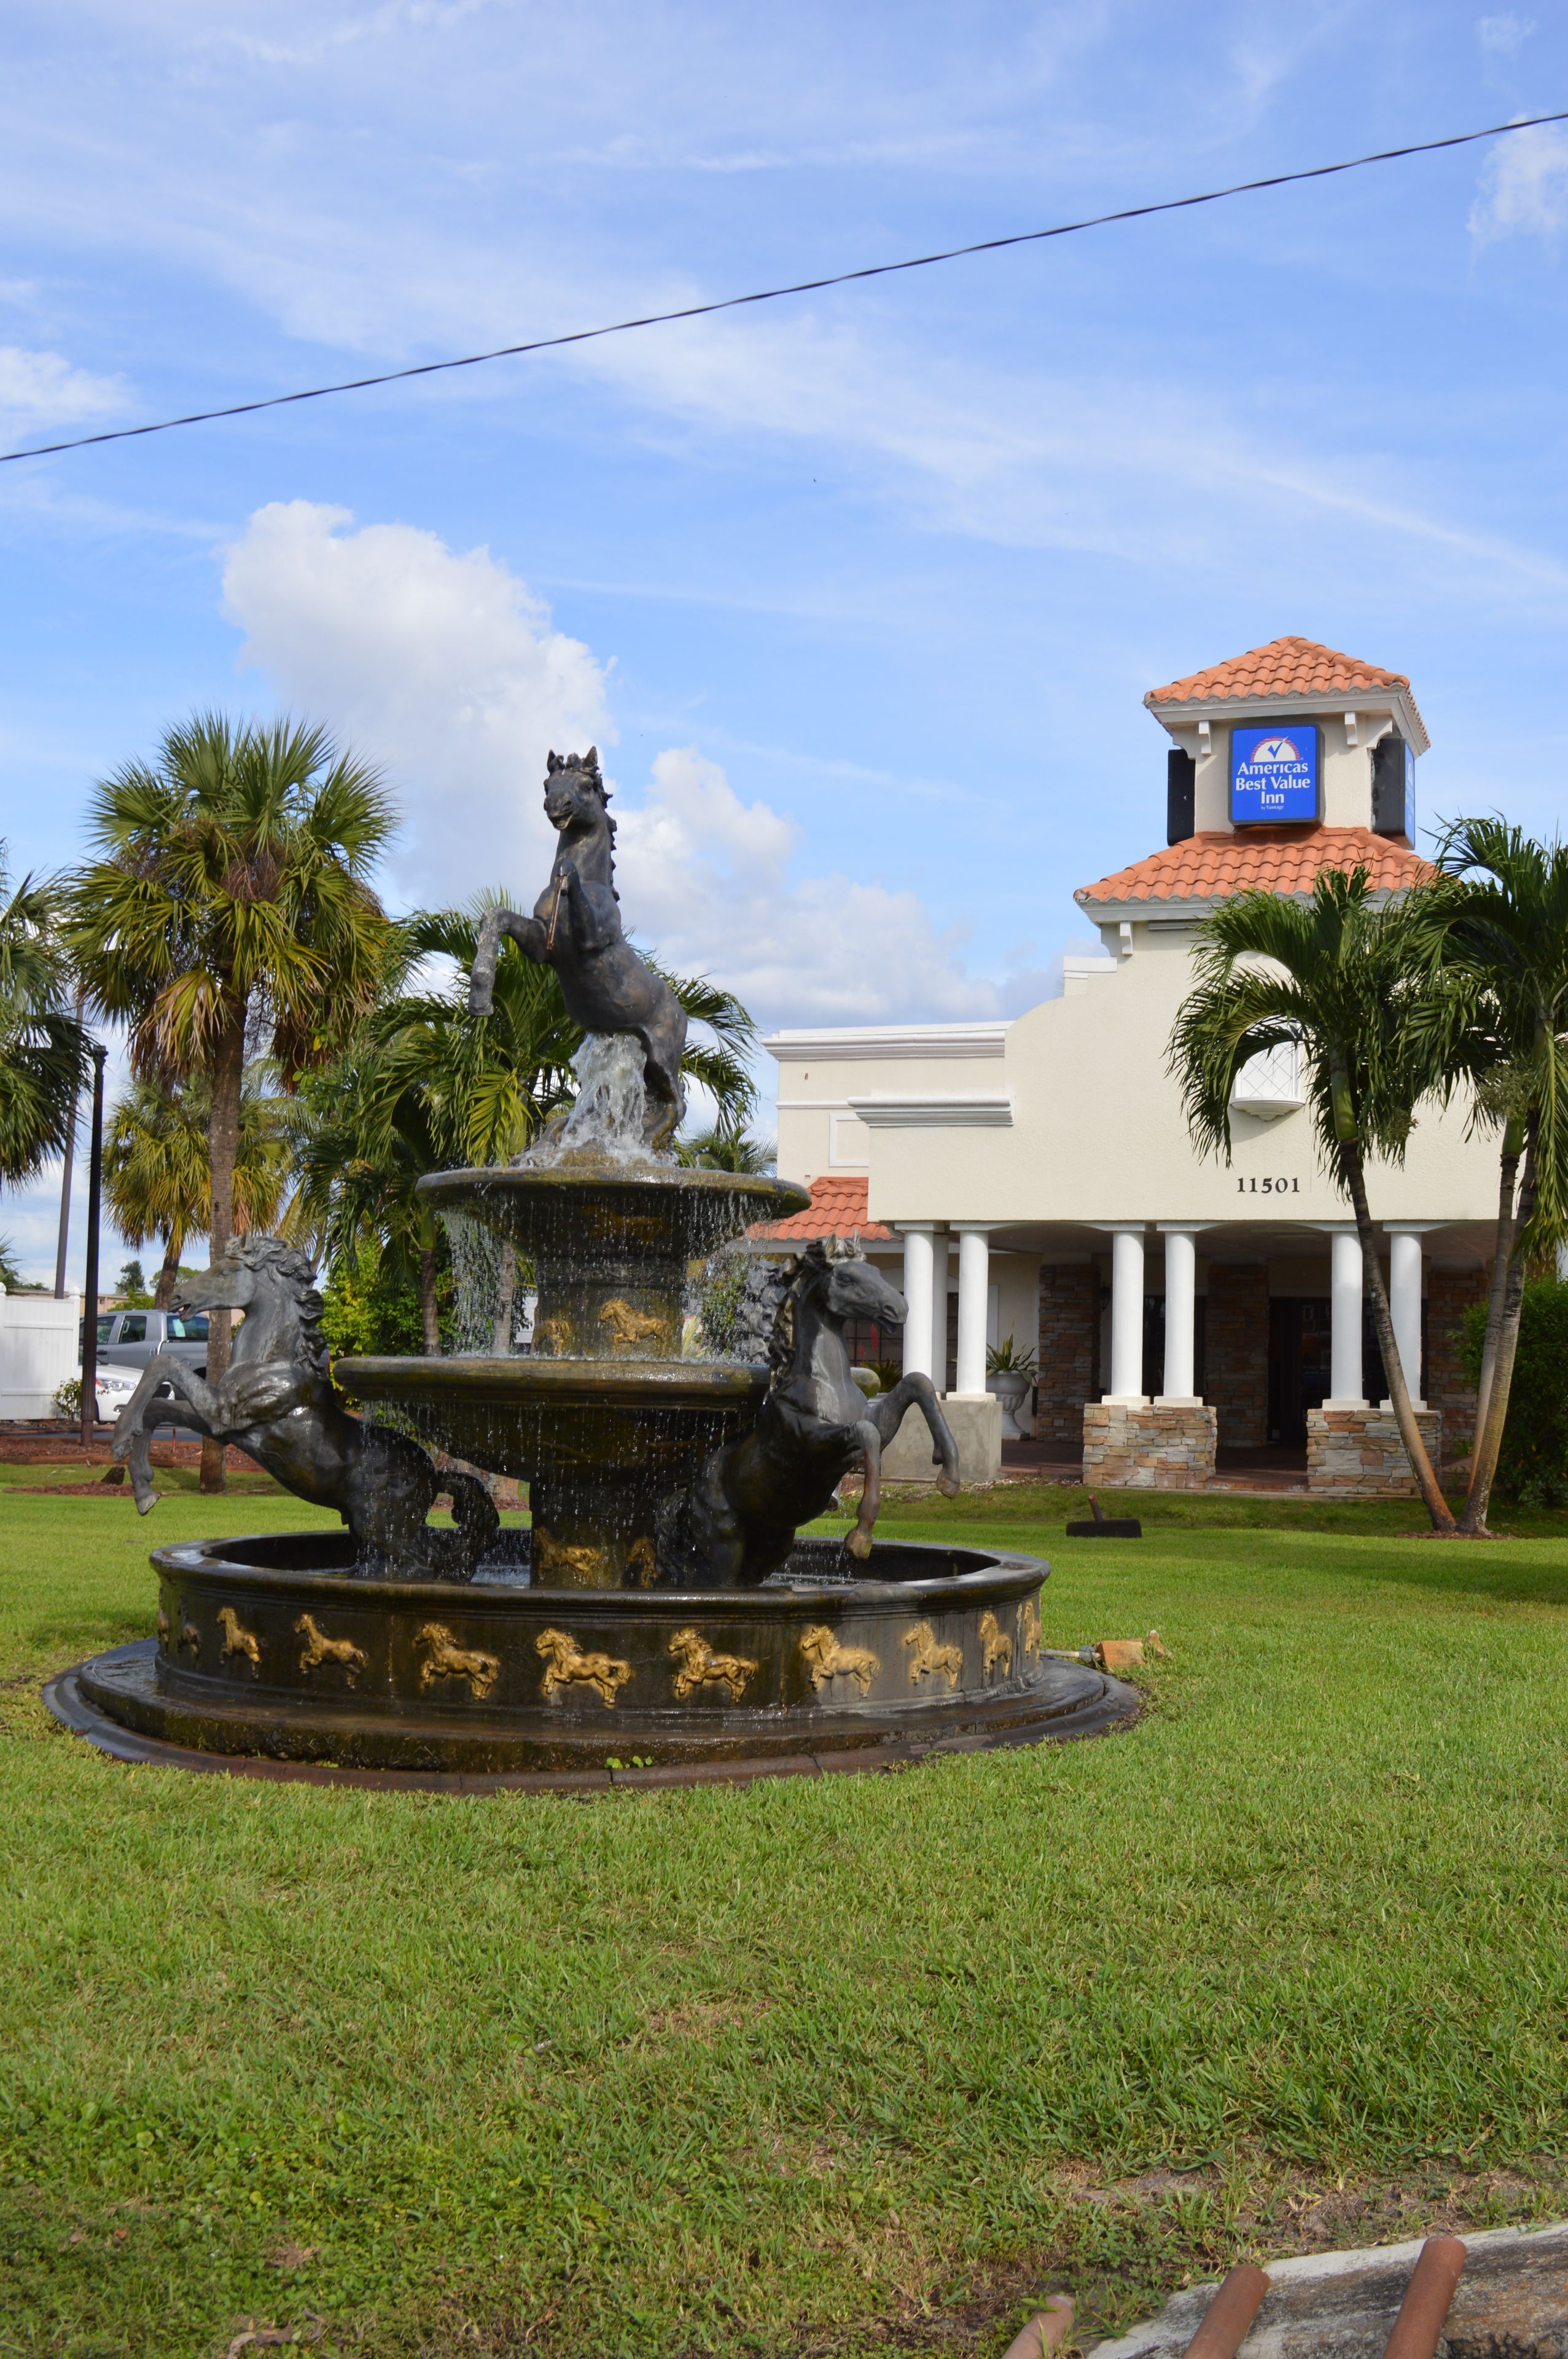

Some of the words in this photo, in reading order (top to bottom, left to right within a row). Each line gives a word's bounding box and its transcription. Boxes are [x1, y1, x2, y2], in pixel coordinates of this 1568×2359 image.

[1238, 762, 1308, 775] Americas
[1236, 777, 1266, 791] Best
[1270, 775, 1310, 789] Value
[1261, 791, 1284, 804] Inn
[1237, 1177, 1300, 1194] 11501
